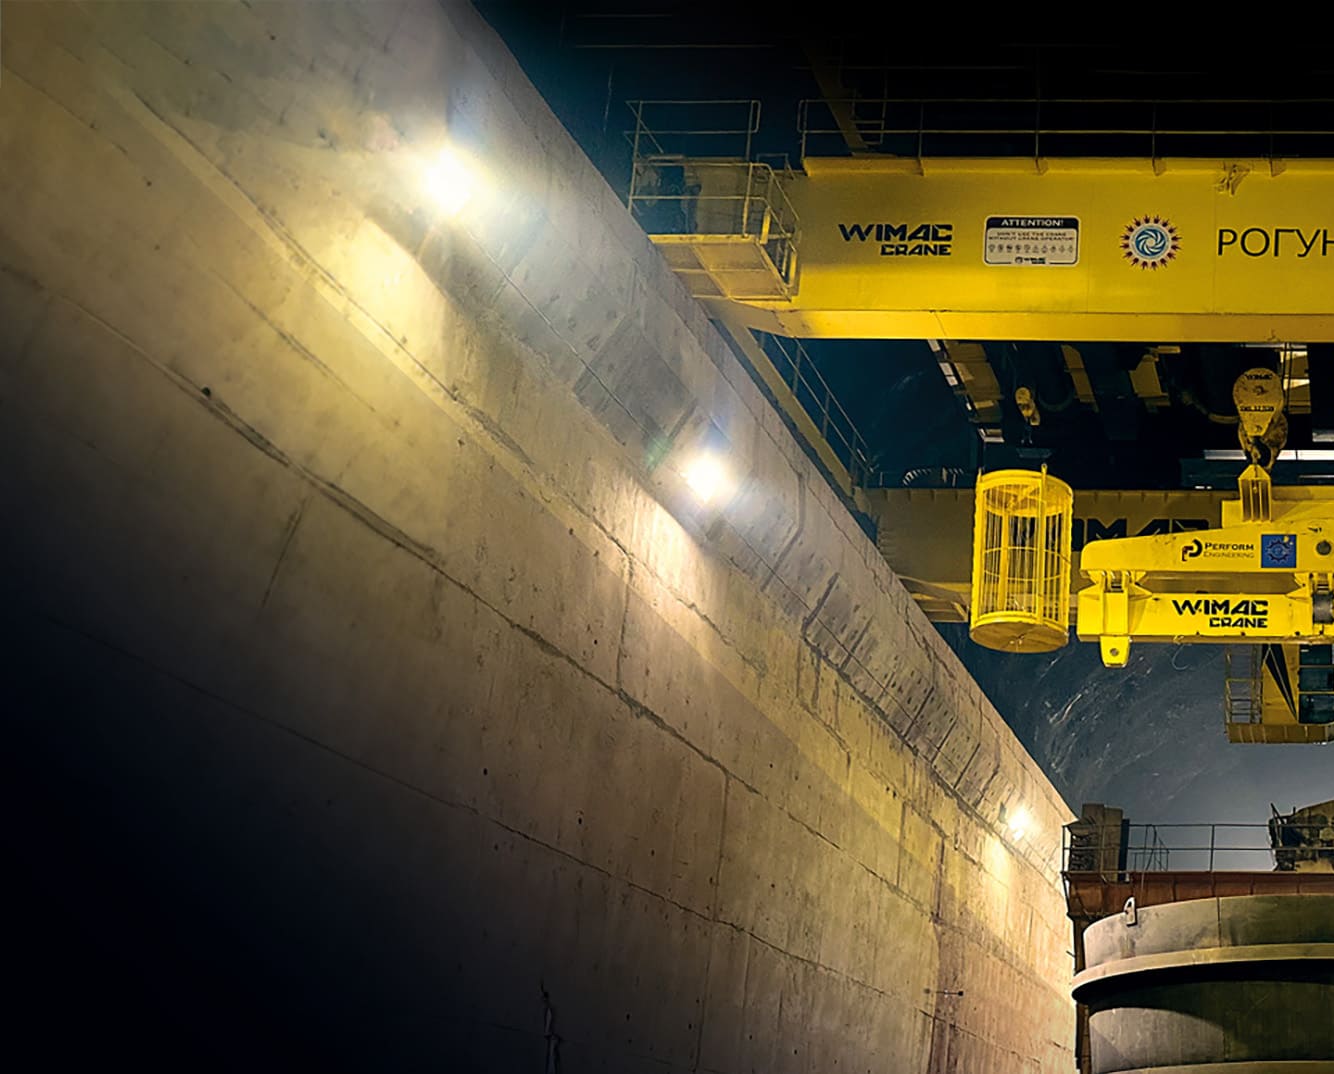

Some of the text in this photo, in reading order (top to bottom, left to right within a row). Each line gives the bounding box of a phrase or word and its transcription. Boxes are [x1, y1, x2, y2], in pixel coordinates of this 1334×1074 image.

[1001, 219, 1064, 227] ATTENTION!
[837, 224, 953, 242] WIMAC
[880, 244, 951, 256] CRANE
[1172, 600, 1268, 615] WIMAC
[1209, 618, 1268, 628] CRANE
